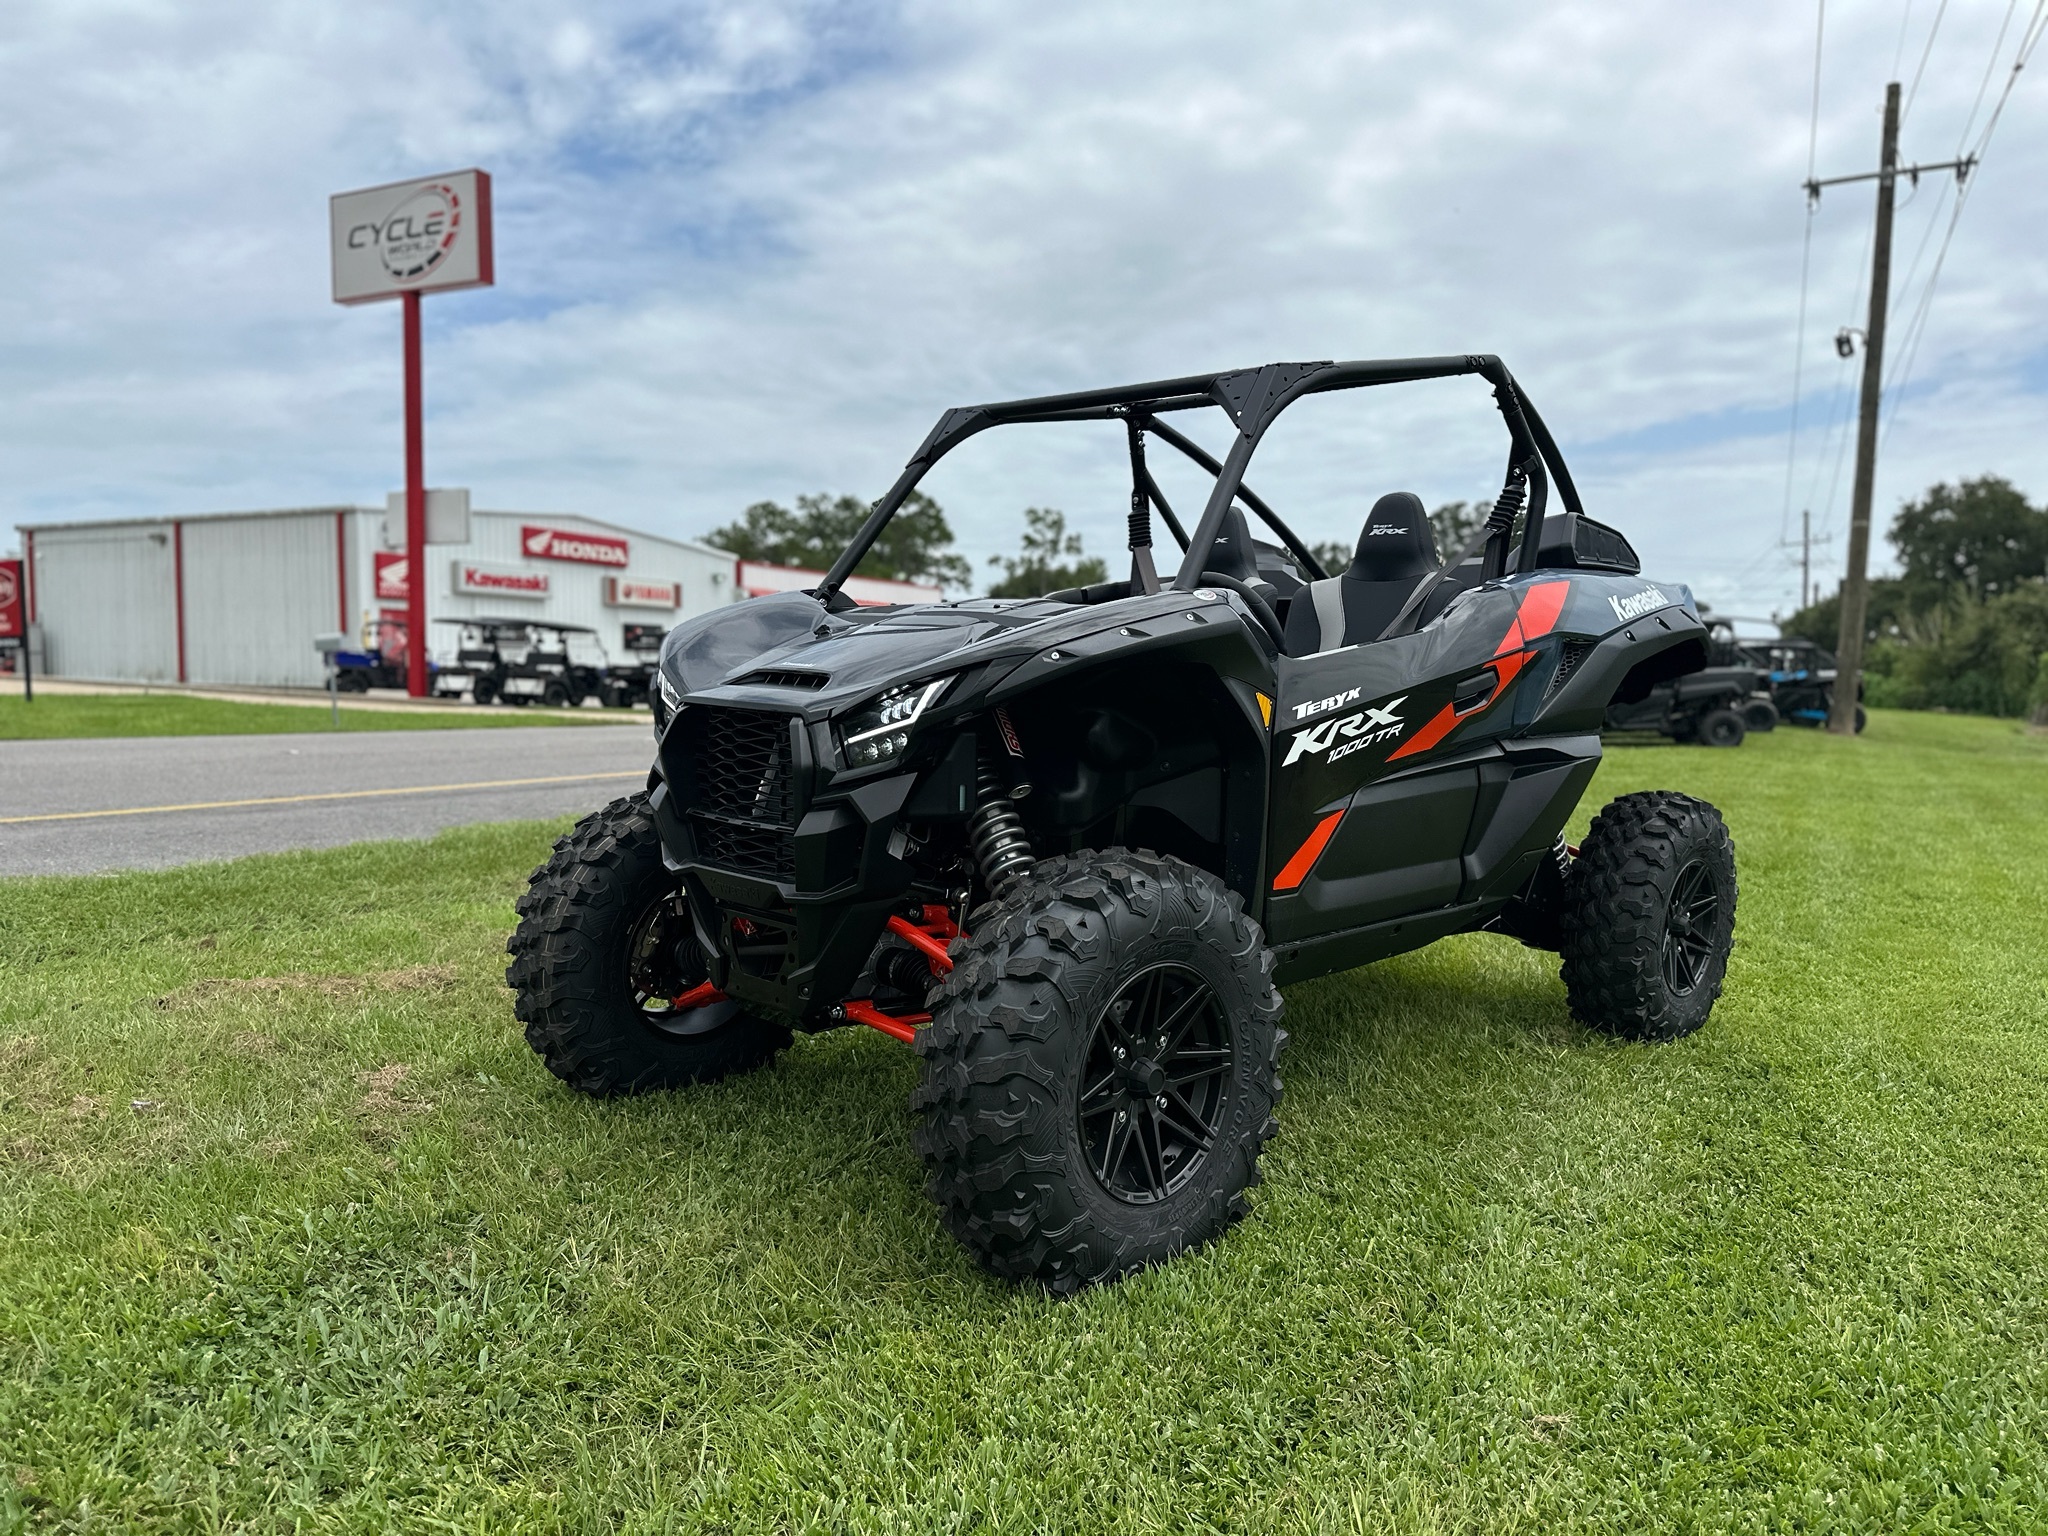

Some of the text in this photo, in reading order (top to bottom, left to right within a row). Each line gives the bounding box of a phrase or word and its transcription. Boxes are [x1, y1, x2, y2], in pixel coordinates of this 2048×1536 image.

[347, 211, 445, 250] CYCLE
[551, 538, 628, 563] HONDA
[1368, 527, 1409, 536] KRX
[465, 567, 549, 592] Kawasaki
[1607, 584, 1669, 622] Kawasaki
[1281, 695, 1409, 768] KRX
[1222, 1018, 1251, 1158] CARNIVORE
